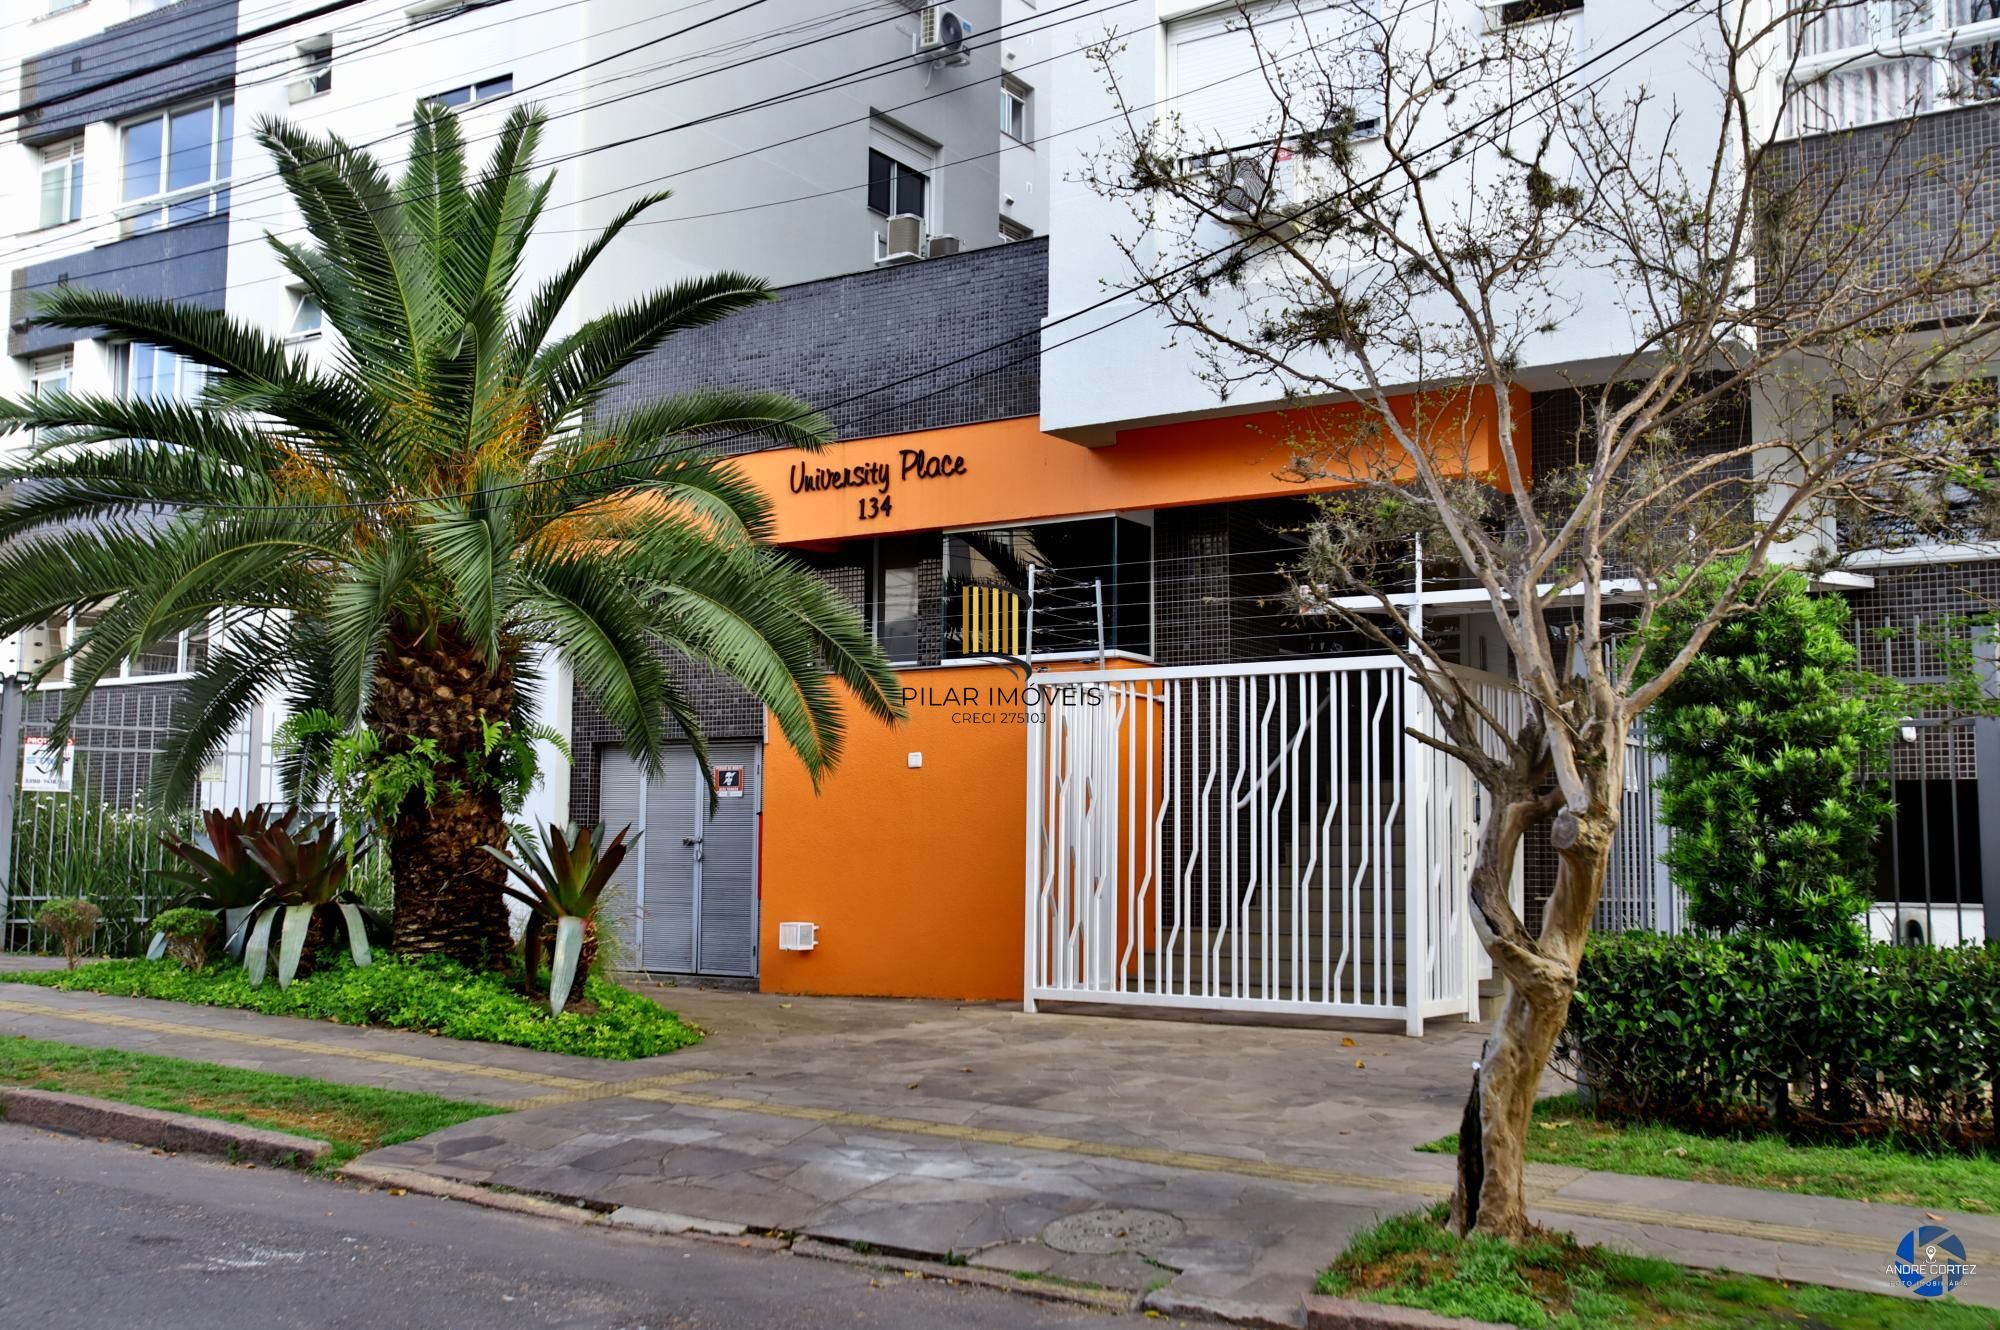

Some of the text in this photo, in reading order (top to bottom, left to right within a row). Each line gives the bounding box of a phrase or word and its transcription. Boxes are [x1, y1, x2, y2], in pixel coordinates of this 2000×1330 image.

[790, 449, 968, 494] University Place
[858, 495, 892, 520] 134
